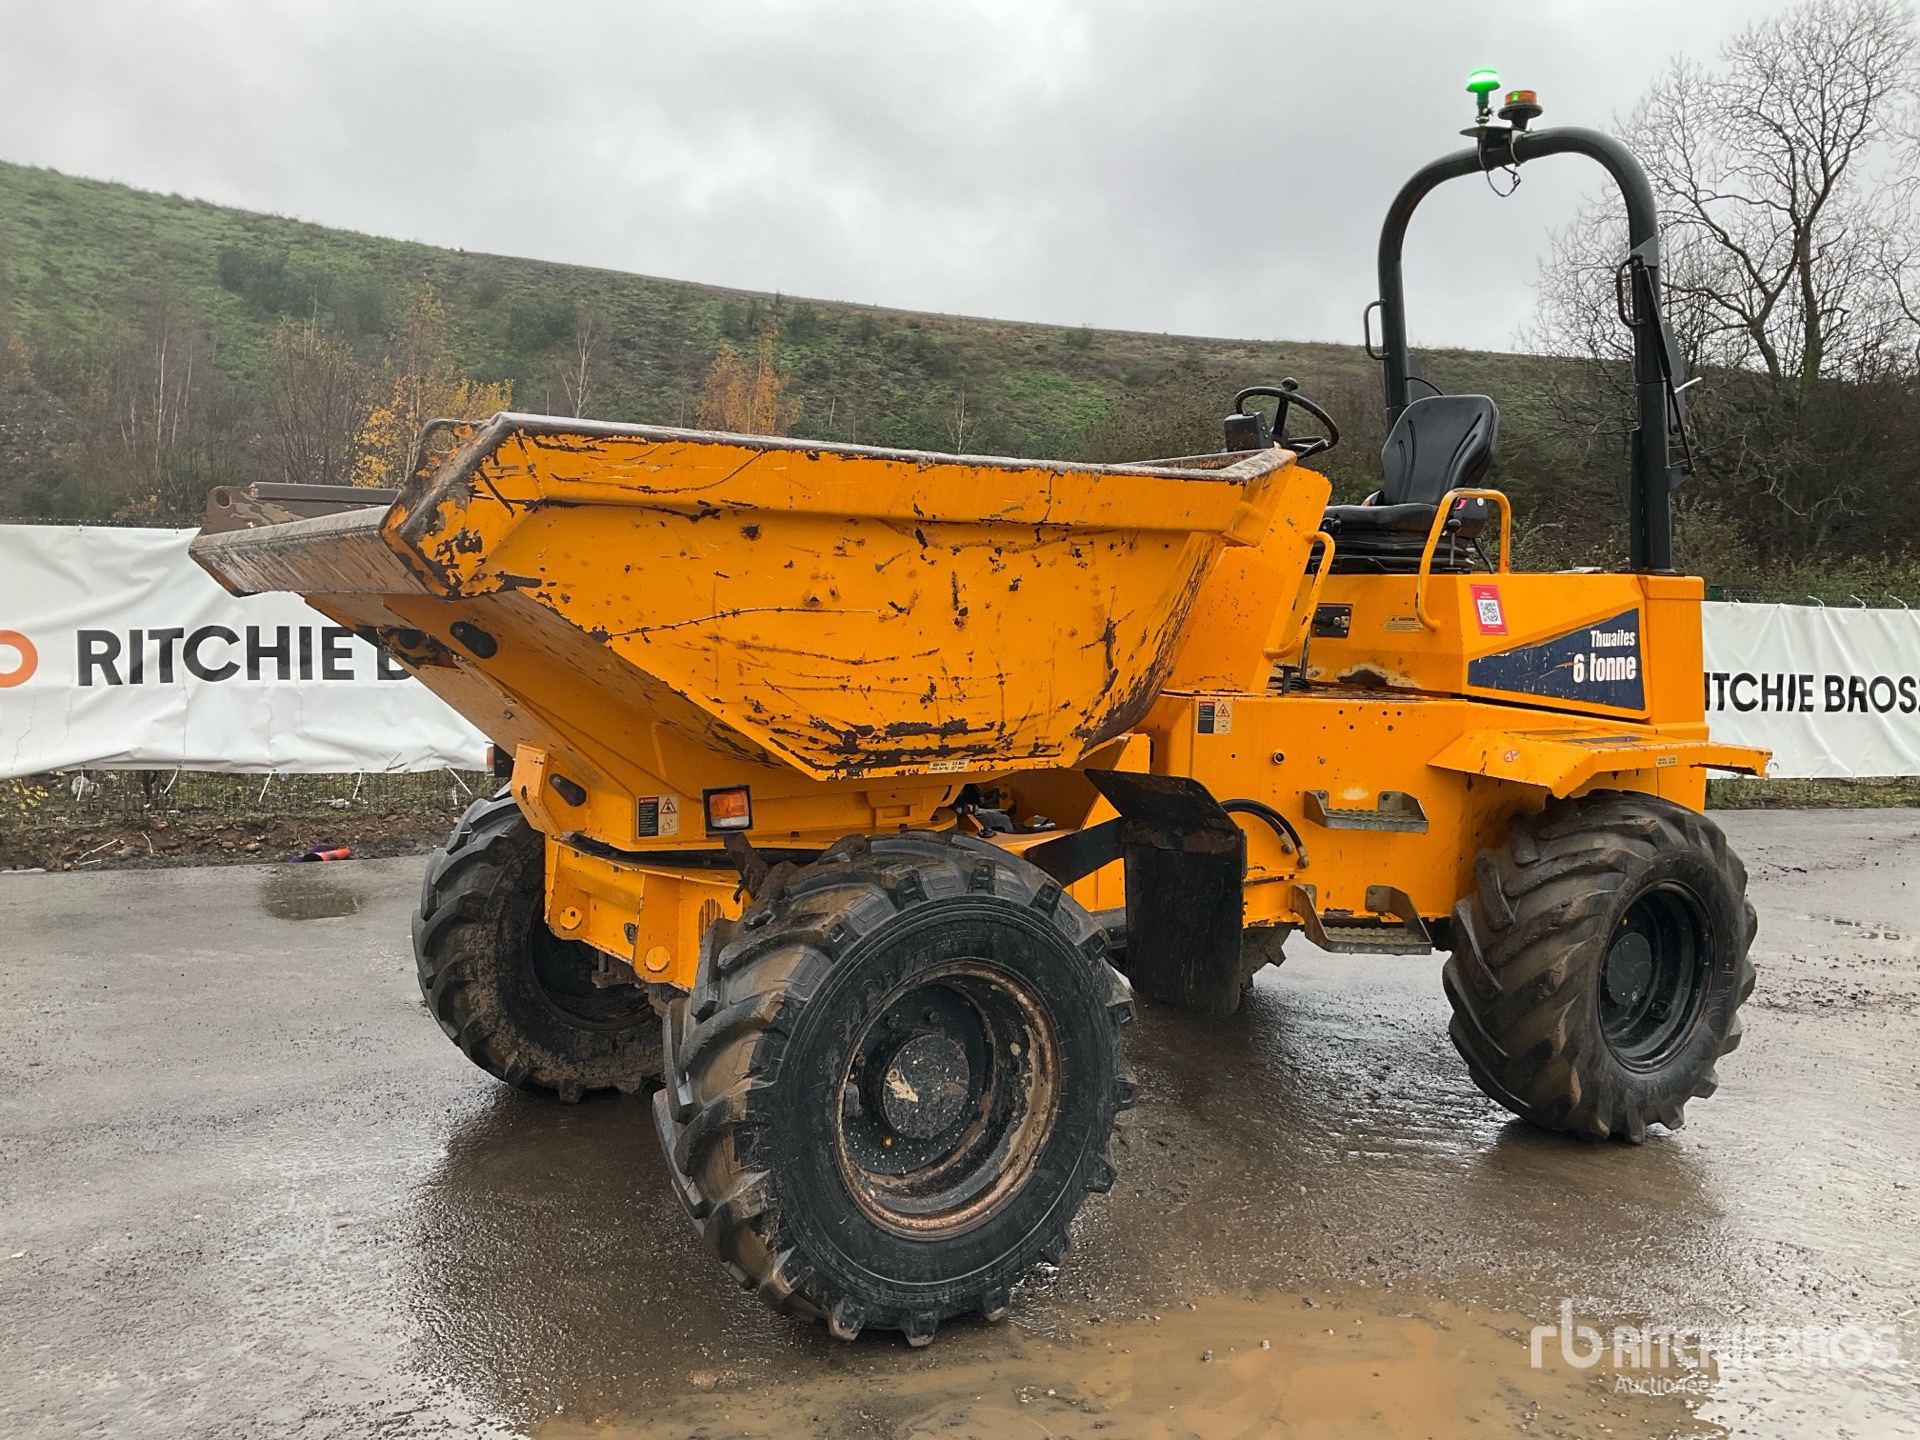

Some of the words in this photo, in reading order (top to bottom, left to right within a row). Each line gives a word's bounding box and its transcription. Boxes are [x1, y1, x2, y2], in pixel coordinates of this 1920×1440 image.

[77, 625, 354, 687] RITCHIE
[1590, 629, 1636, 648] Thwaites
[1573, 653, 1585, 683] 6
[1589, 652, 1637, 682] tonne
[1704, 672, 1814, 713] ITCHIE
[1825, 675, 1920, 714] BROS
